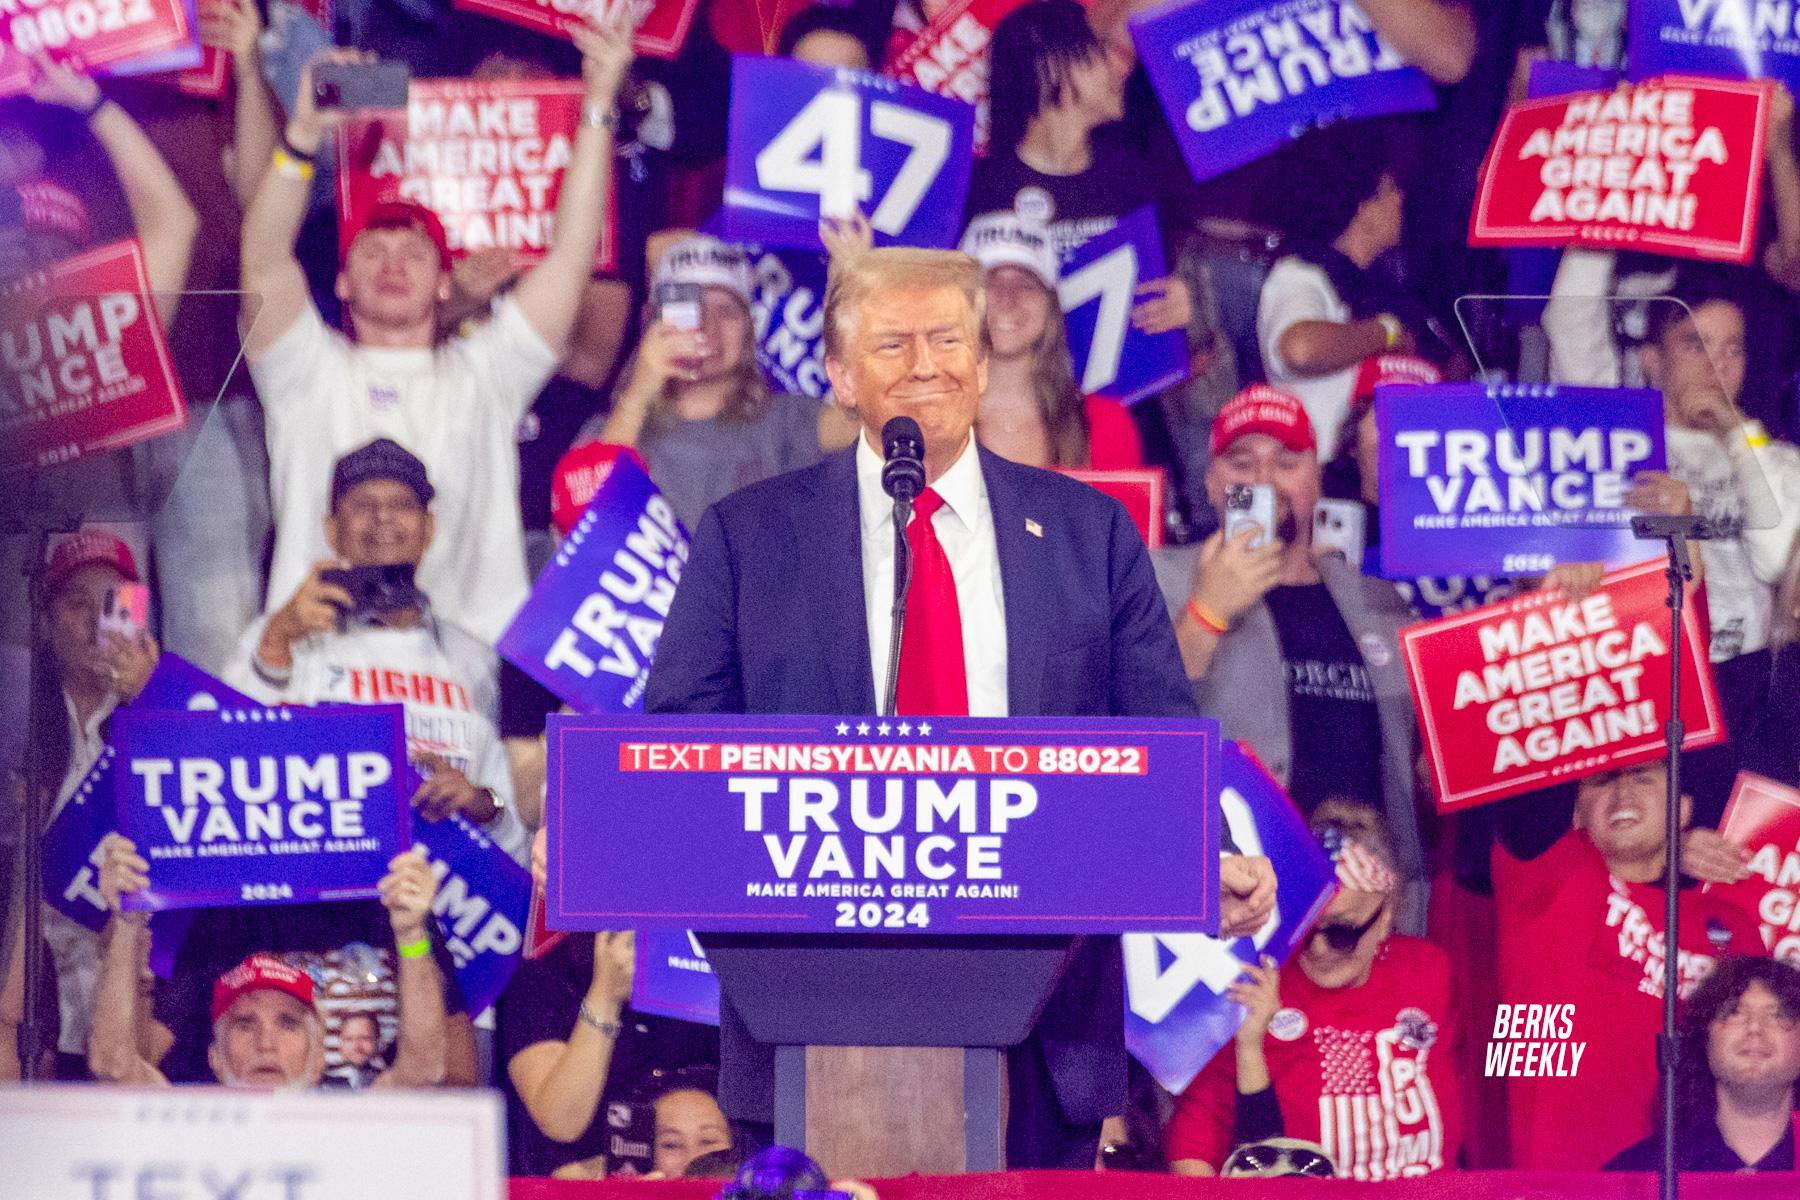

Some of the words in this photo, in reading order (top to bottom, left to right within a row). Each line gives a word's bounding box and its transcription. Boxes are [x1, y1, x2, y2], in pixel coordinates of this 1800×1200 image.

[406, 100, 538, 138] MAKE
[1563, 88, 1695, 128] MAKE
[369, 132, 574, 179] AMERICA
[755, 90, 953, 237] 47
[1518, 125, 1729, 166] AMERICA
[1539, 156, 1698, 196] GREAT
[1529, 188, 1699, 231] AGAIN!
[2, 290, 140, 373] UMP
[1057, 243, 1136, 396] 7
[19, 336, 130, 408] NCE
[1394, 426, 1652, 479] TRUMP
[1426, 471, 1628, 515] VANCE
[1413, 514, 1457, 530] MAKE
[1460, 512, 1528, 528] AMERICA
[1584, 510, 1633, 525] AGAIN
[544, 493, 679, 679] TRUMP
[1502, 555, 1556, 573] 2024
[1478, 592, 1618, 664] MAKE
[1453, 622, 1668, 711] AMERICA
[1485, 664, 1645, 736] GREAT
[627, 744, 711, 770] TEXT
[720, 745, 976, 772] PENNSYLVANIA
[984, 747, 1028, 772] TO
[1037, 748, 1141, 774] 88022
[1492, 699, 1659, 775] AGAIN!
[130, 751, 392, 807] TRUMP
[161, 800, 365, 844] VANCE
[727, 777, 1039, 834] TRUMP
[149, 845, 195, 859] MAKE
[198, 842, 267, 857] AMERICA
[268, 839, 320, 855] GREAT
[323, 837, 380, 853] AGAIN!
[762, 833, 1003, 880] VANCE
[240, 882, 294, 900] 2024
[746, 882, 798, 898] MAKE
[803, 883, 885, 898] AMERICA
[890, 884, 950, 899] GREAT
[954, 884, 1019, 899] AGAIN!
[834, 902, 930, 928] 2024
